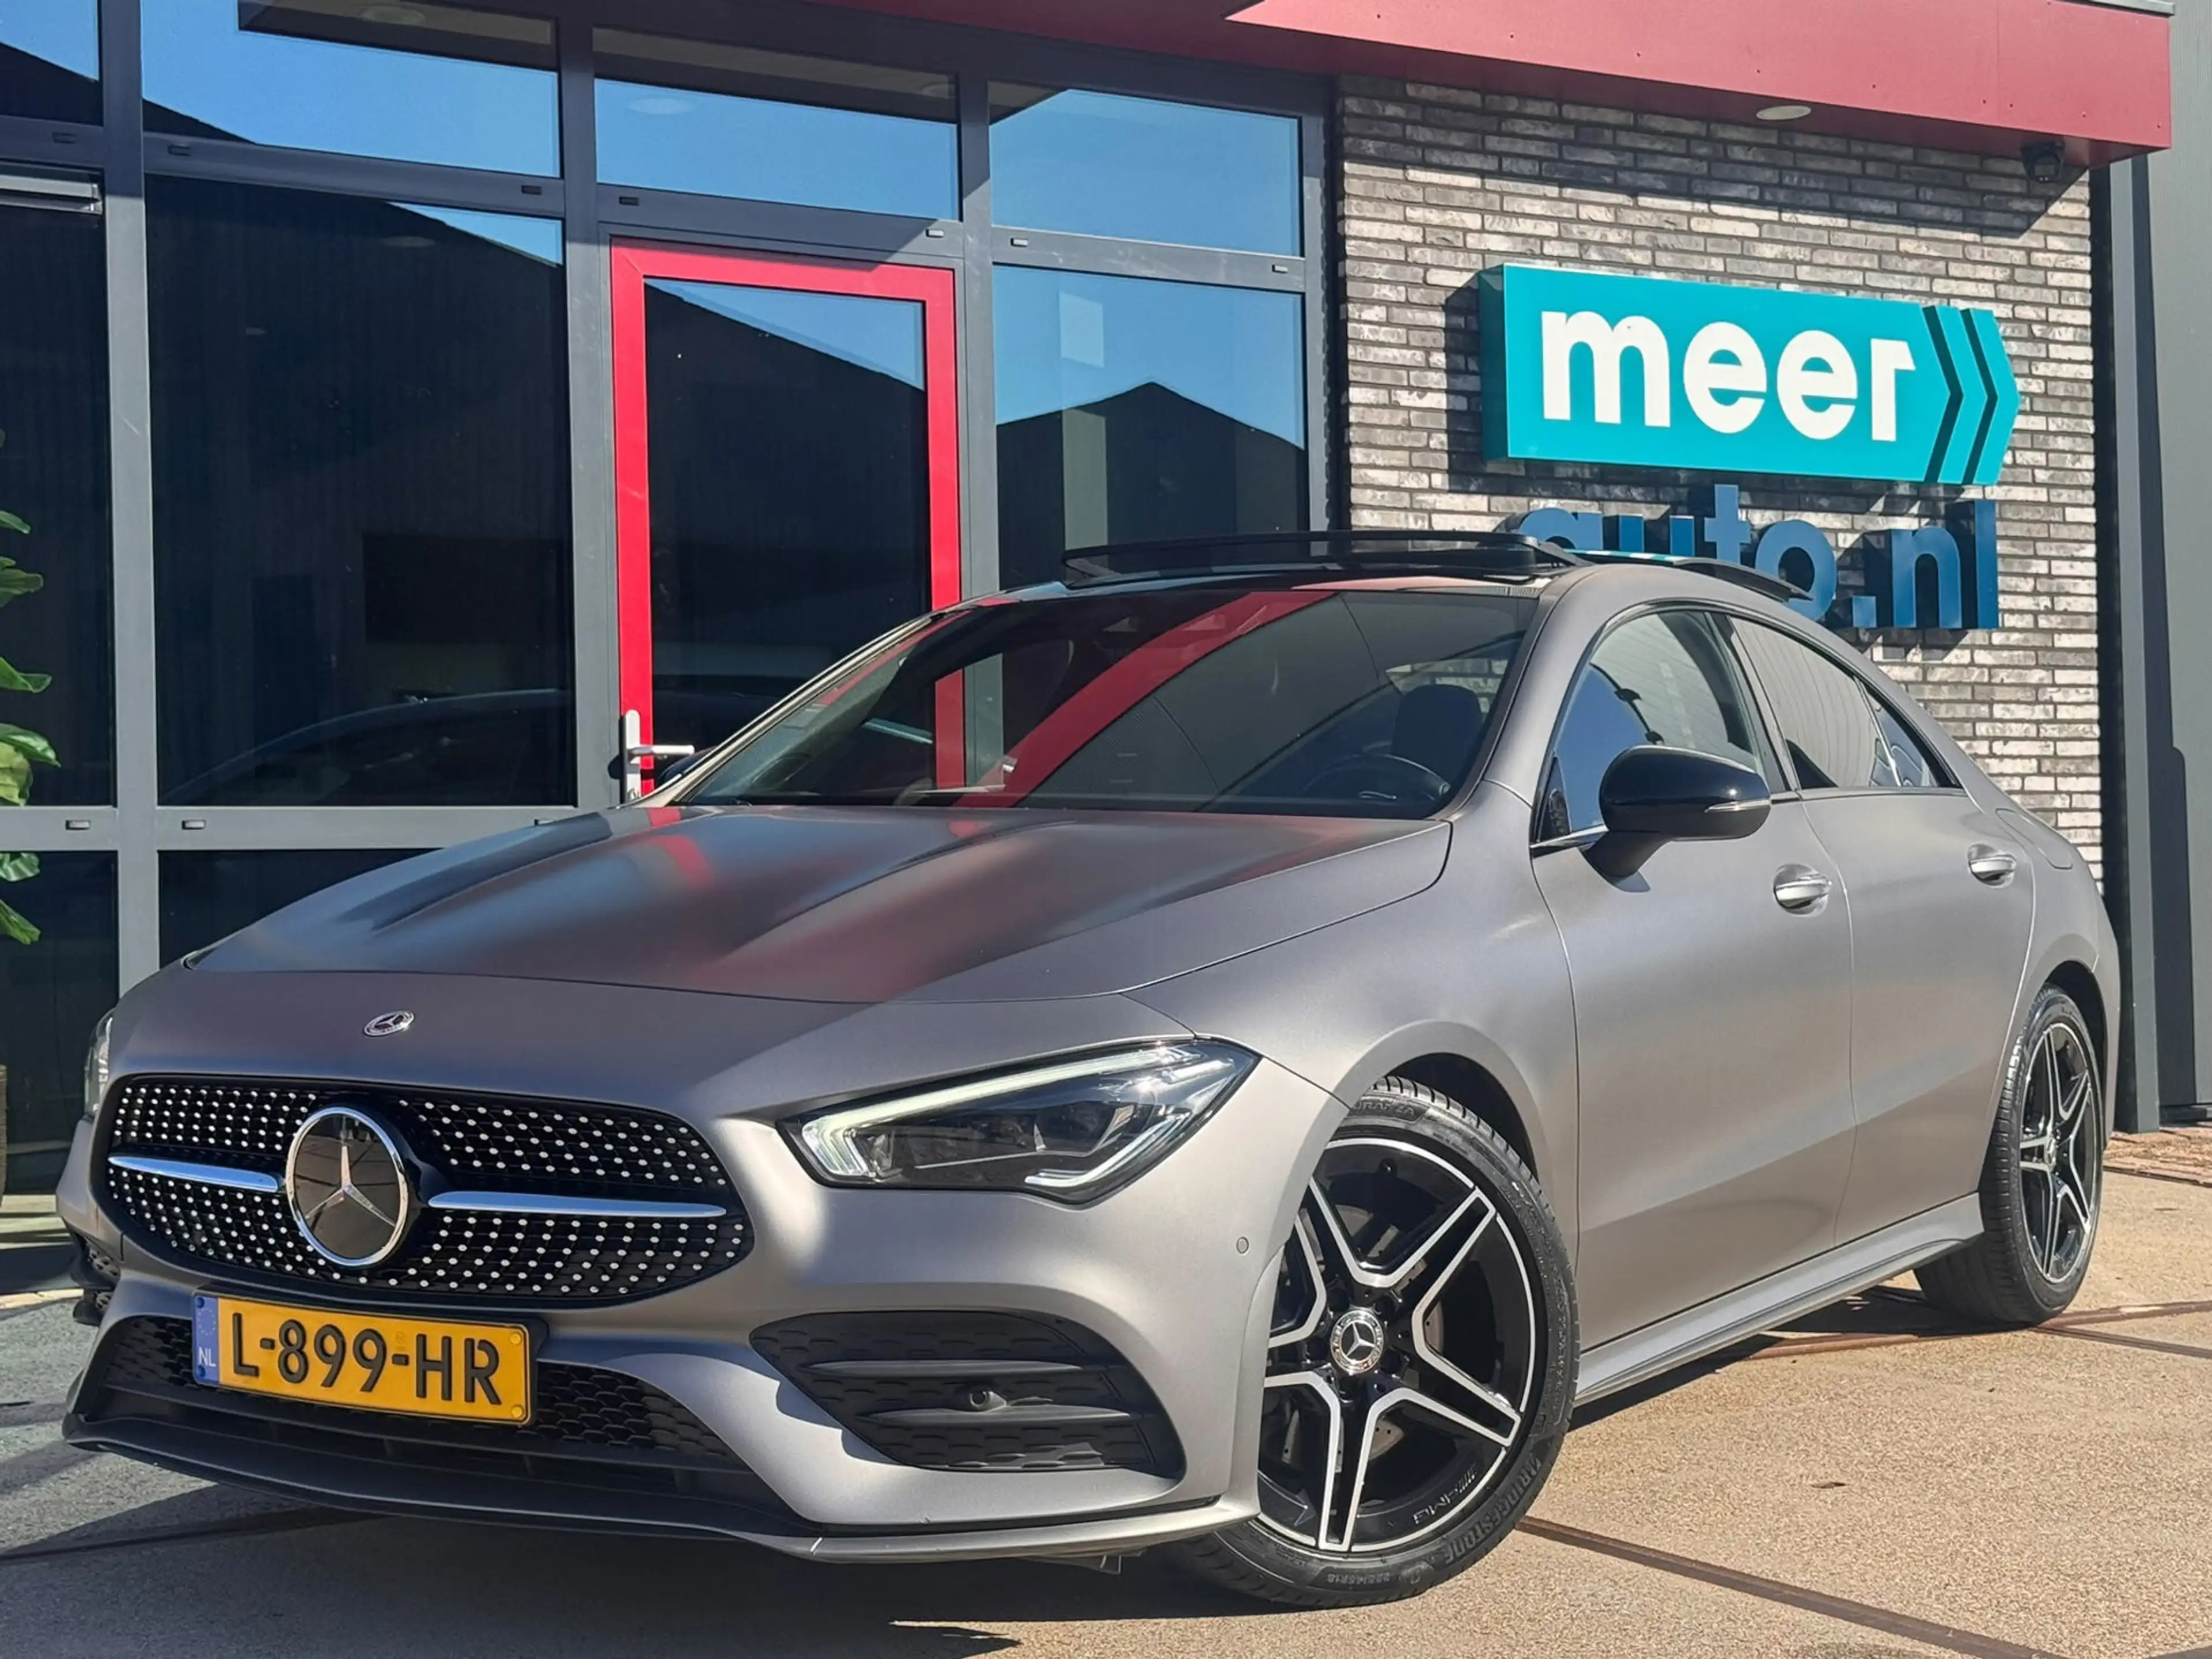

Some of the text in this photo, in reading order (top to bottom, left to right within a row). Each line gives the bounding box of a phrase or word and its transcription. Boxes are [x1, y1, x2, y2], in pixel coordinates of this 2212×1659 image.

[1541, 310, 1916, 441] meer
[199, 1347, 217, 1368] NL
[232, 1312, 502, 1406] L-899-HR
